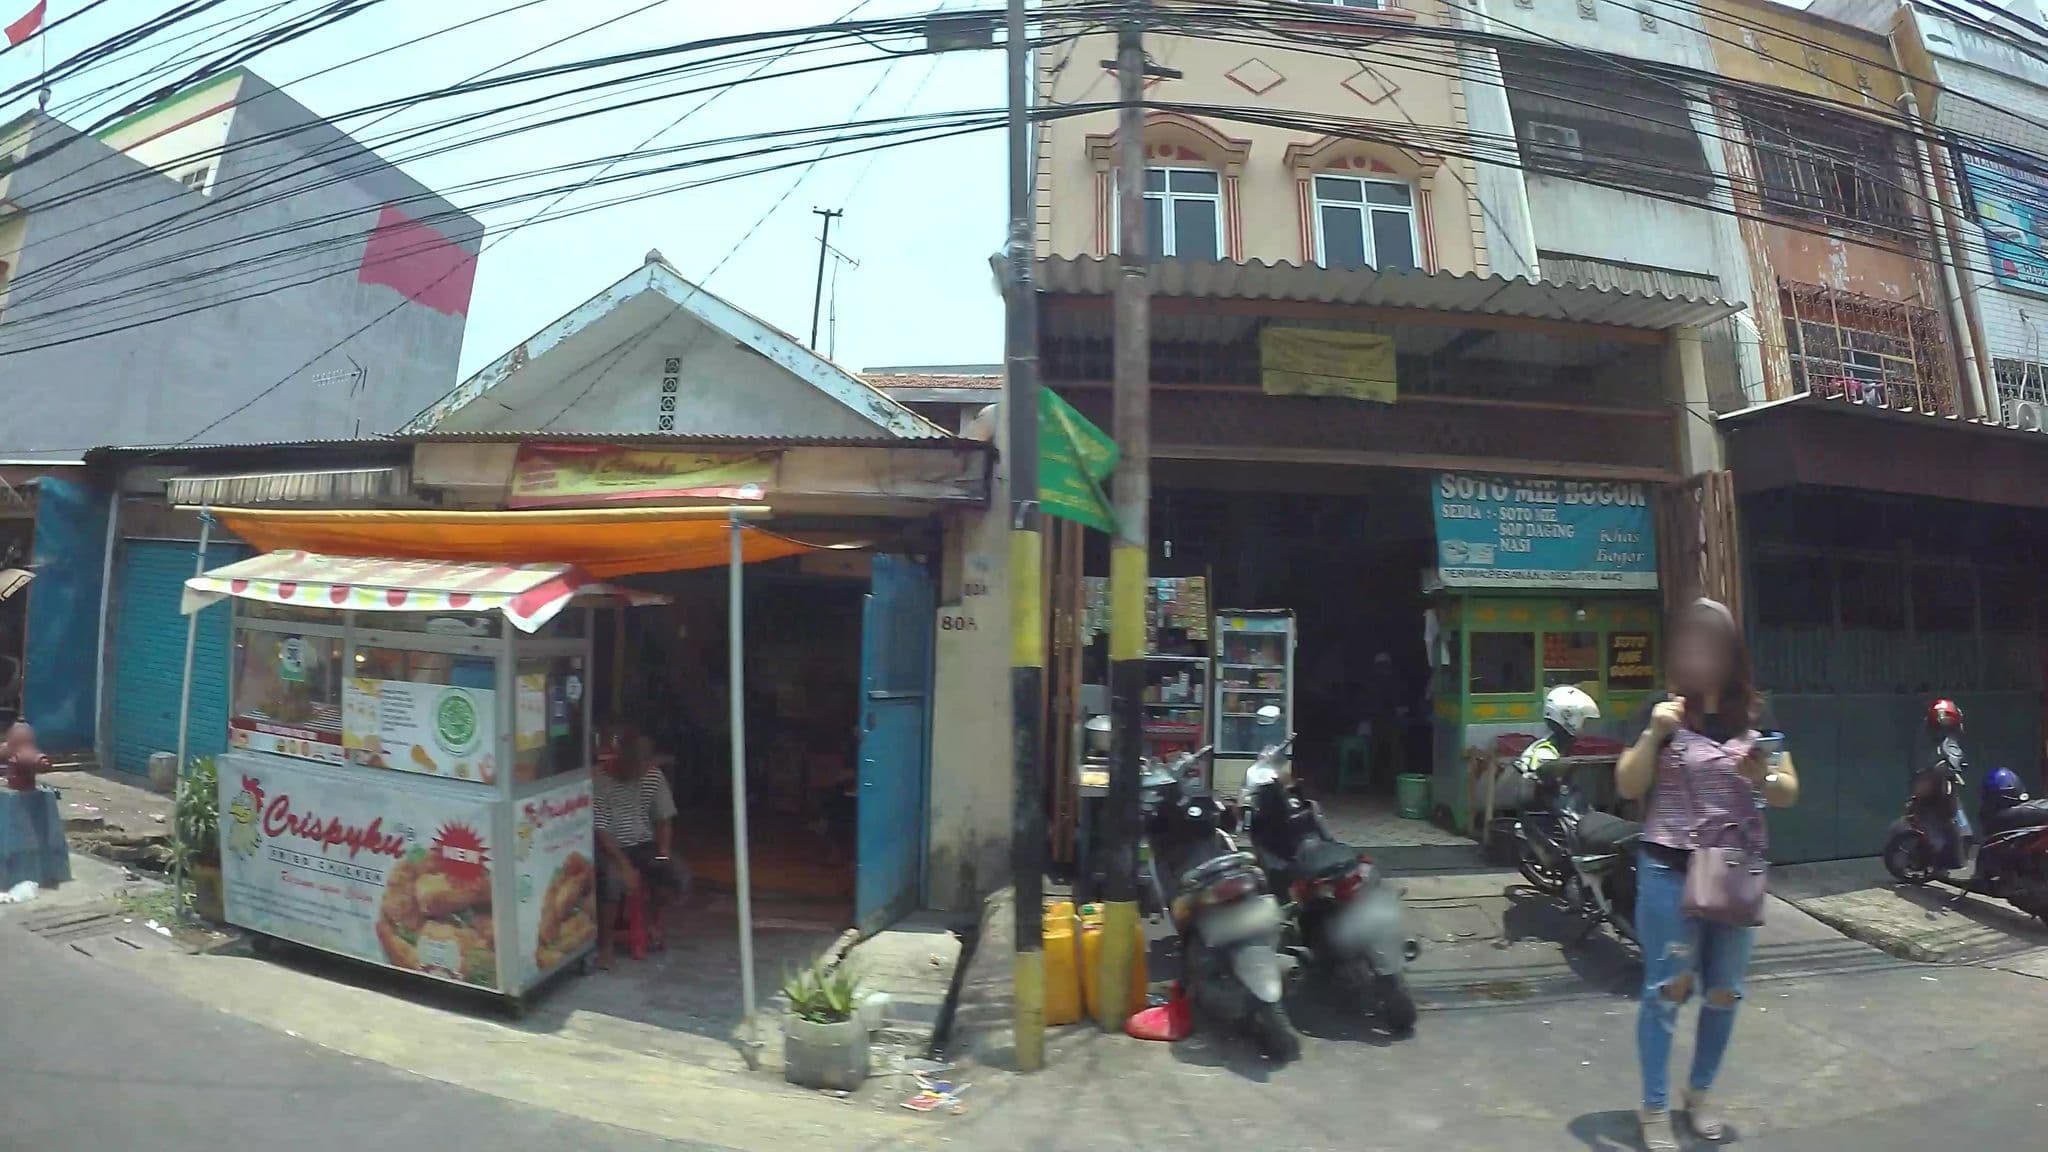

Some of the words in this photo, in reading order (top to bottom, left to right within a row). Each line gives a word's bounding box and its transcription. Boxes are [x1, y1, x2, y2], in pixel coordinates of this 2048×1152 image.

[1441, 474, 1508, 501] SOTO
[1514, 479, 1559, 504] MIE
[1564, 481, 1646, 507] BOGOR
[1442, 504, 1482, 519] SEDIA
[1500, 507, 1534, 521] SOTO
[1500, 523, 1524, 537] SOP
[1527, 524, 1575, 538] DAGING
[1500, 539, 1532, 552] NASI
